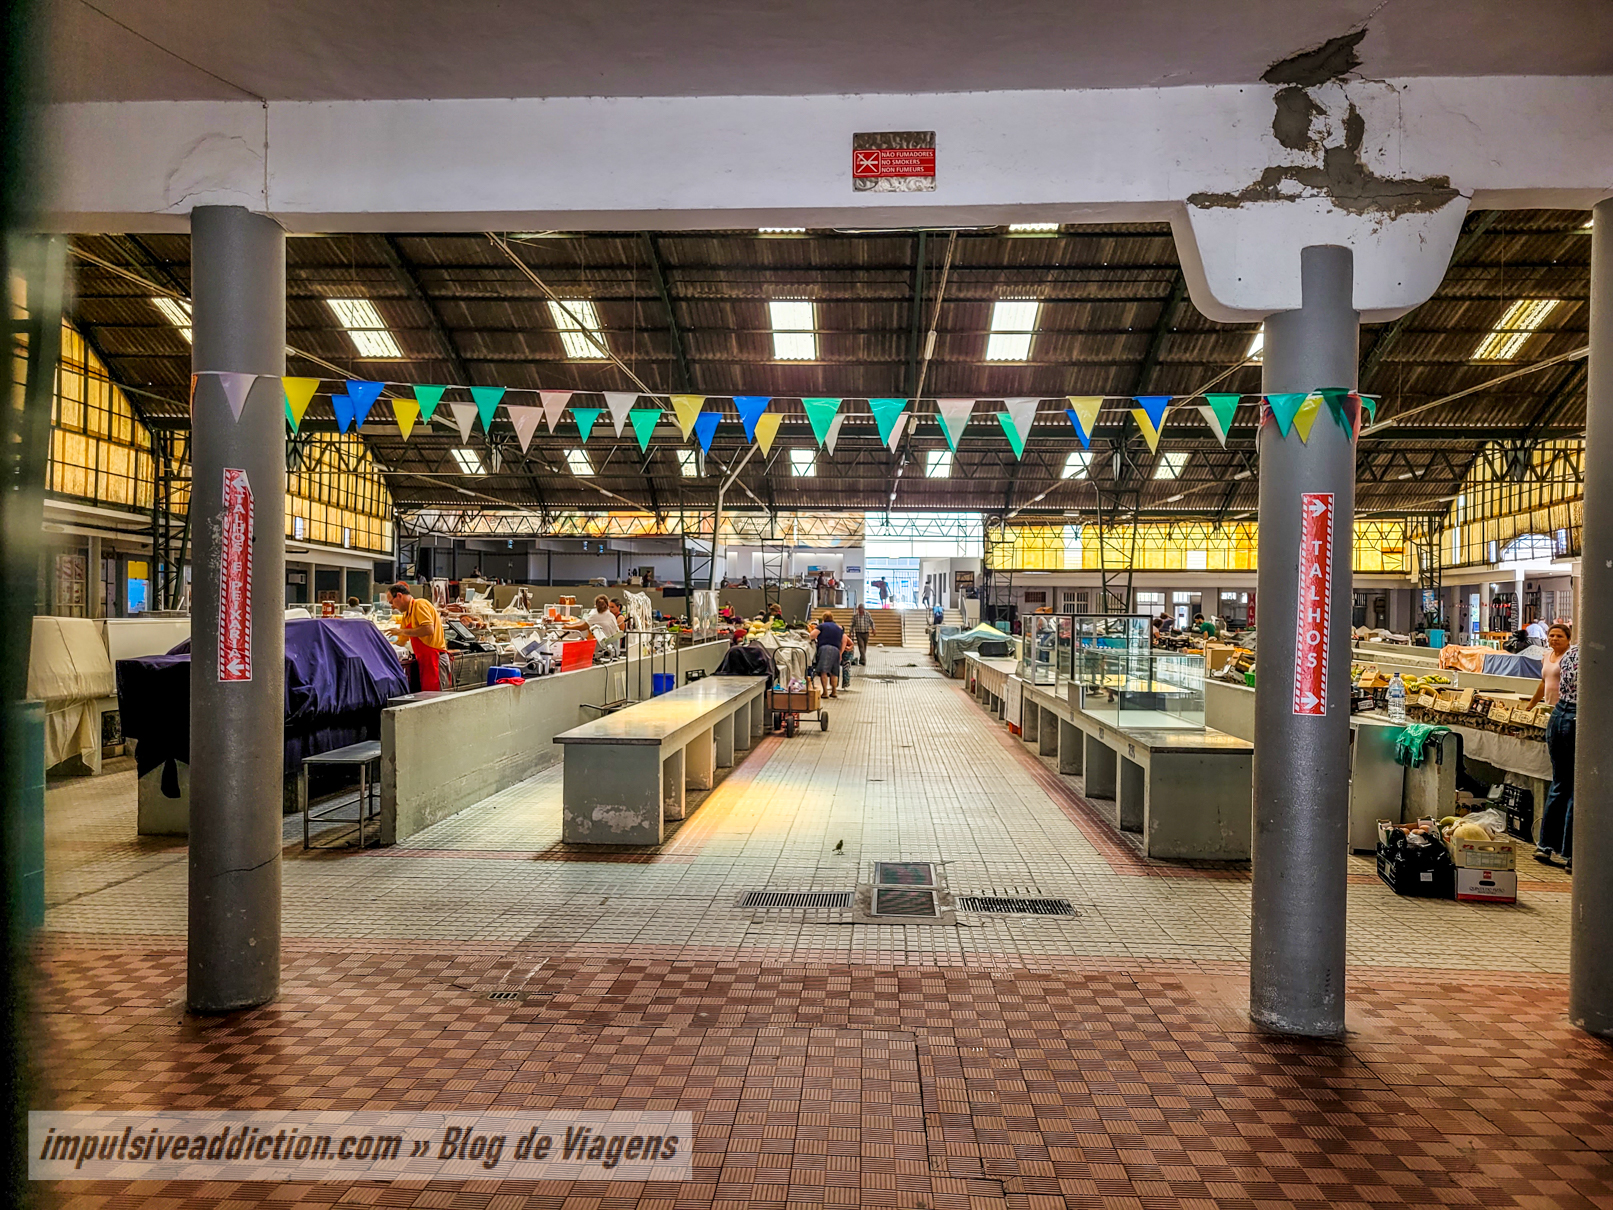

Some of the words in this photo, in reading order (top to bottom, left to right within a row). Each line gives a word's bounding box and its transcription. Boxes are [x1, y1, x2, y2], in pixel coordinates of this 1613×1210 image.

[231, 494, 246, 552] TALHOS
[232, 561, 243, 572] E
[228, 580, 244, 658] PEIXARIA
[1306, 540, 1323, 668] TALHOS
